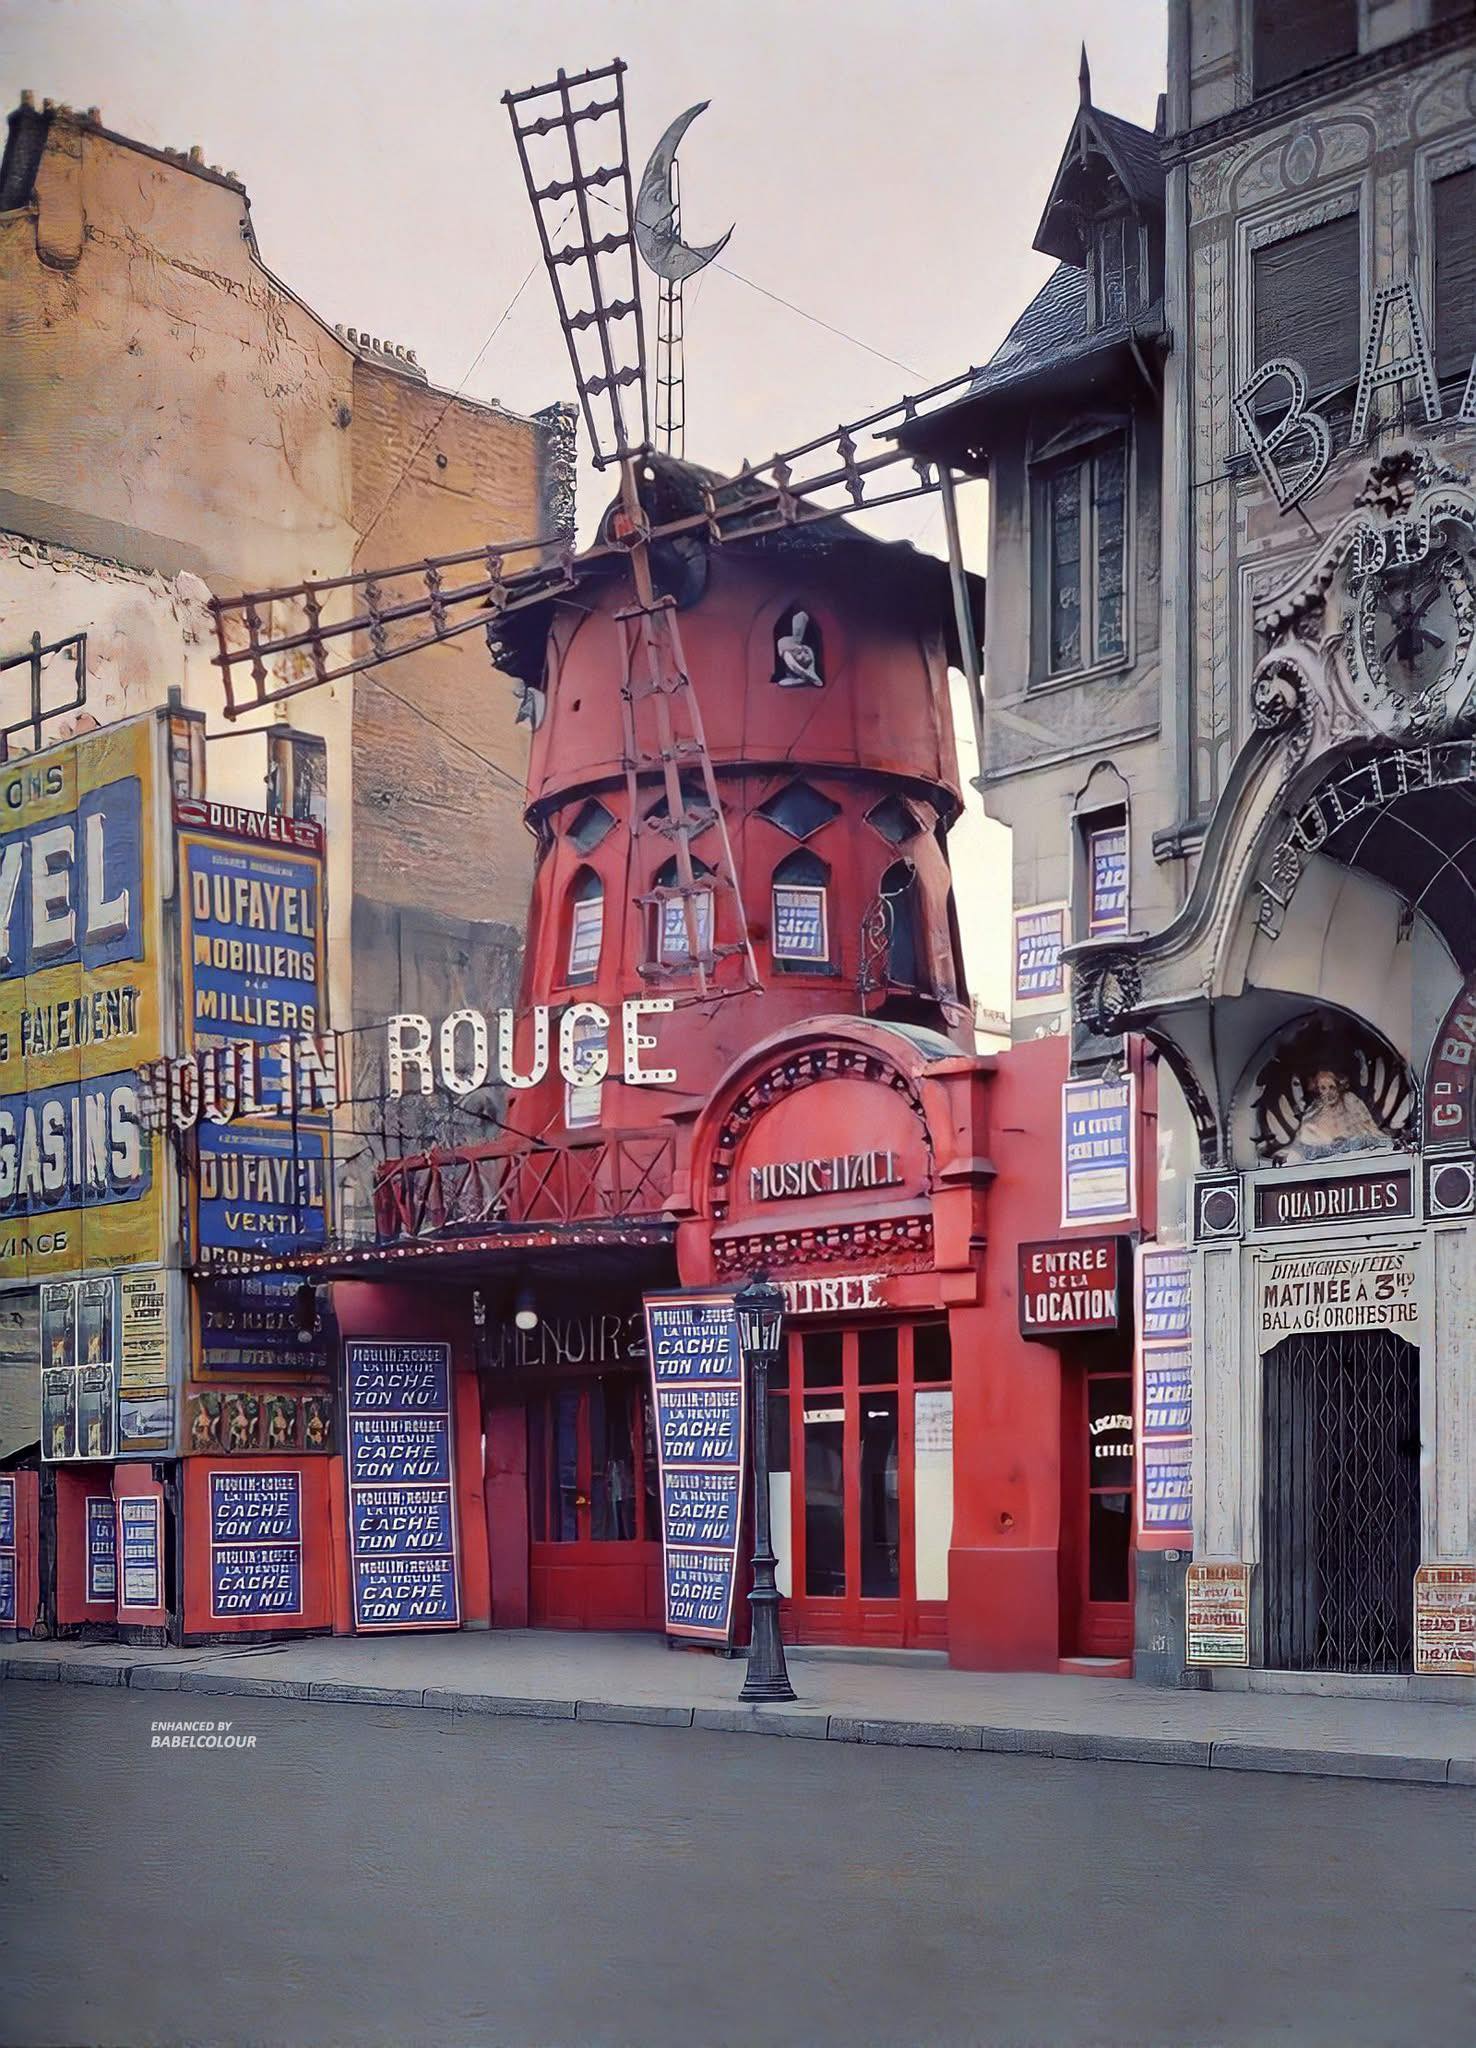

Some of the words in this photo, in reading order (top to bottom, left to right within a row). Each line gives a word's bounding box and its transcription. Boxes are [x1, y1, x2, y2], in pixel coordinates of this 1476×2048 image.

[1233, 284, 1476, 515] BA
[210, 804, 293, 841] DUFAYEL
[193, 871, 315, 938] DUFAYEL
[194, 935, 315, 982] MOBILIERS
[196, 990, 315, 1031] MILLIERS
[387, 999, 677, 1101] ROUGE
[1278, 1183, 1398, 1223] QUADRILLES
[1032, 1249, 1107, 1273] ENTREE
[776, 1274, 888, 1313] NTREE
[1025, 1289, 1117, 1323] LOCATION
[1262, 1312, 1290, 1330] BAL
[1324, 1303, 1418, 1328] ORCHESTRE
[658, 1338, 730, 1354] CACHE
[657, 1359, 691, 1374] TON
[355, 1375, 435, 1387] CACHE
[354, 1391, 392, 1405] TON
[664, 1422, 732, 1437] CACHE
[357, 1445, 438, 1459] CACHE
[665, 1441, 694, 1456] TON
[356, 1463, 394, 1476] TON
[217, 1504, 289, 1517] CACHE
[216, 1521, 251, 1535] TON
[360, 1517, 440, 1530] CACHE
[358, 1534, 397, 1548] TON
[218, 1576, 291, 1590] CACHE
[363, 1585, 445, 1599] CACHE
[217, 1595, 252, 1608] TON
[362, 1603, 400, 1617] TON
